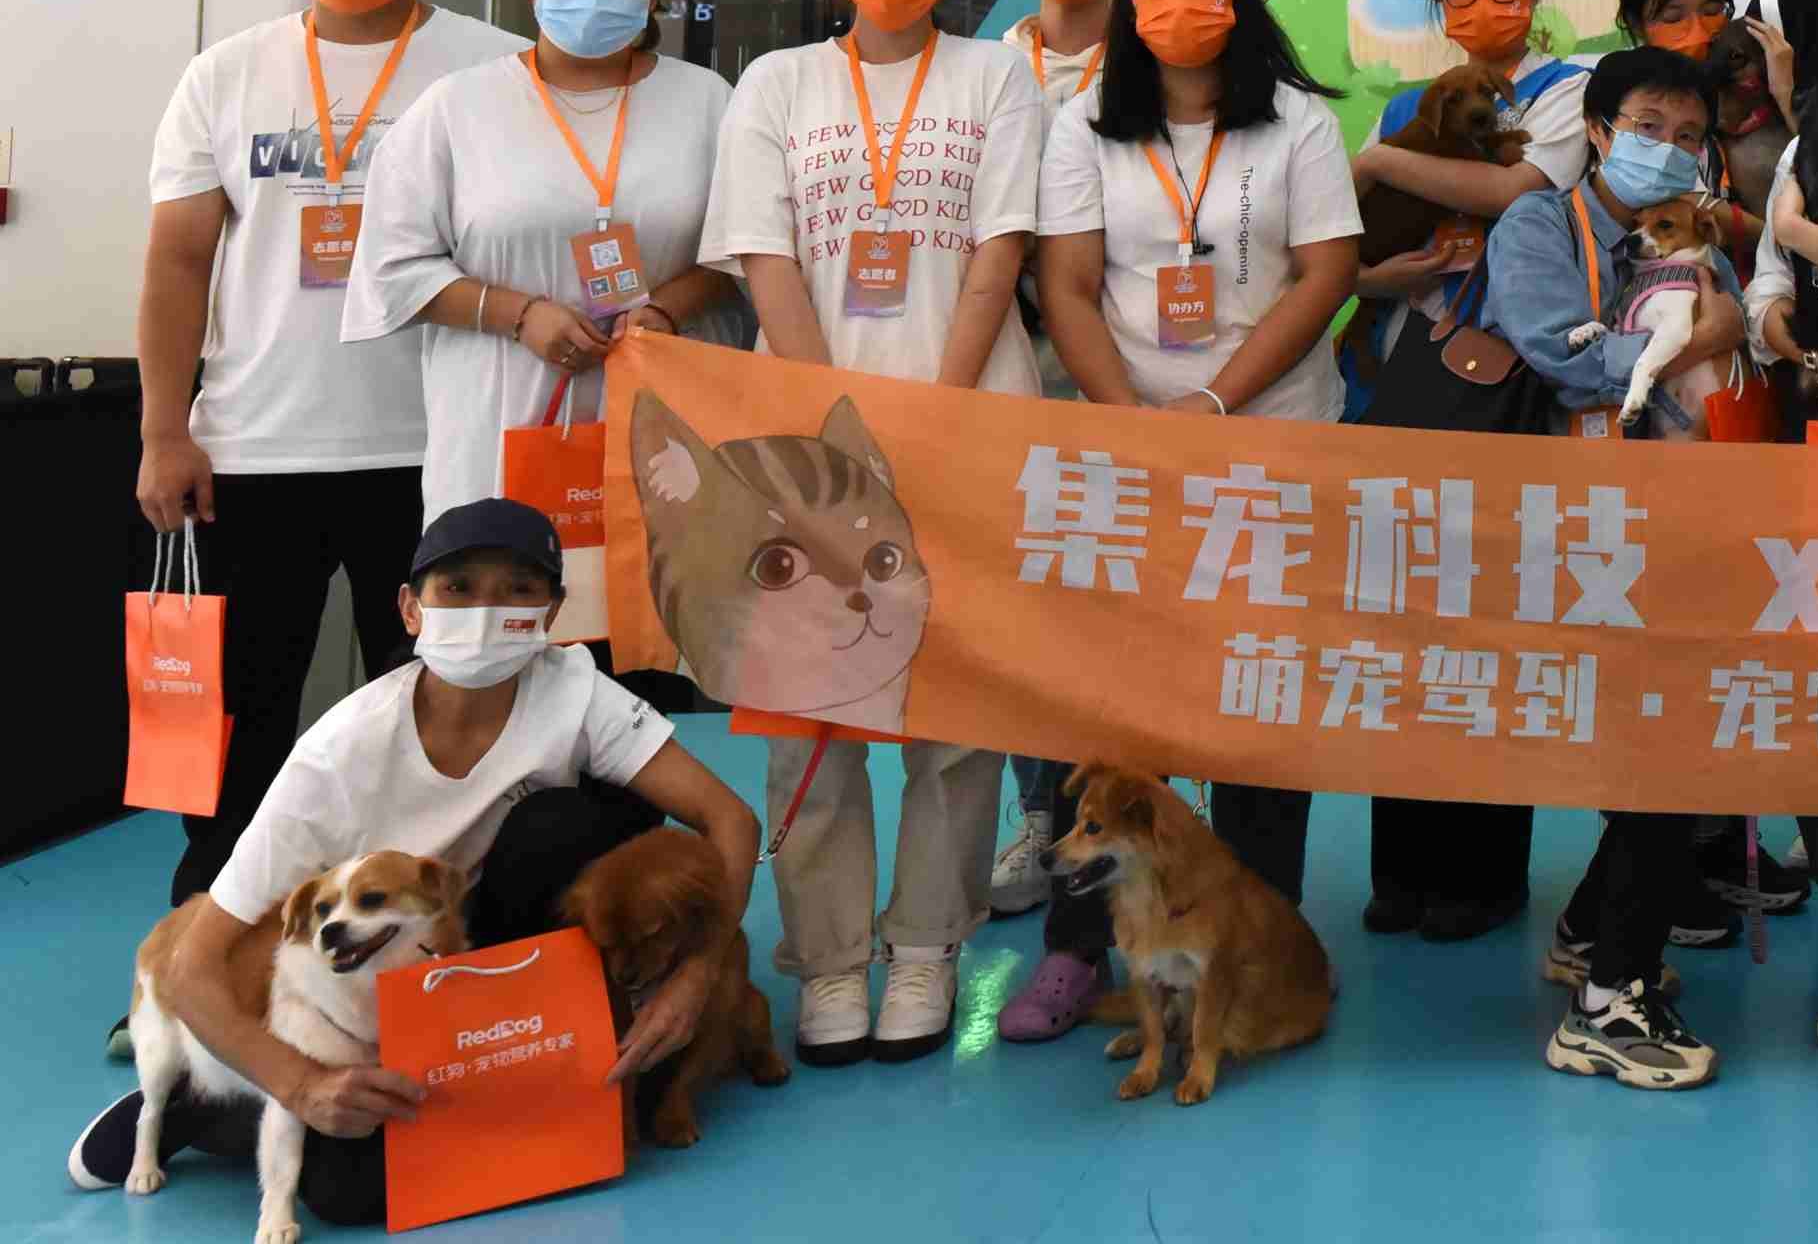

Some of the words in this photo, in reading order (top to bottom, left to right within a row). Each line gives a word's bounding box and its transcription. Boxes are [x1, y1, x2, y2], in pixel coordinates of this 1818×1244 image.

[786, 135, 798, 152] A
[807, 124, 856, 146] FEW
[804, 147, 853, 174] FEW
[805, 175, 850, 204] FEW
[1236, 165, 1254, 285] The-chic-opening
[1015, 444, 1648, 628] 集宠科技
[456, 1014, 544, 1050] RedDog
